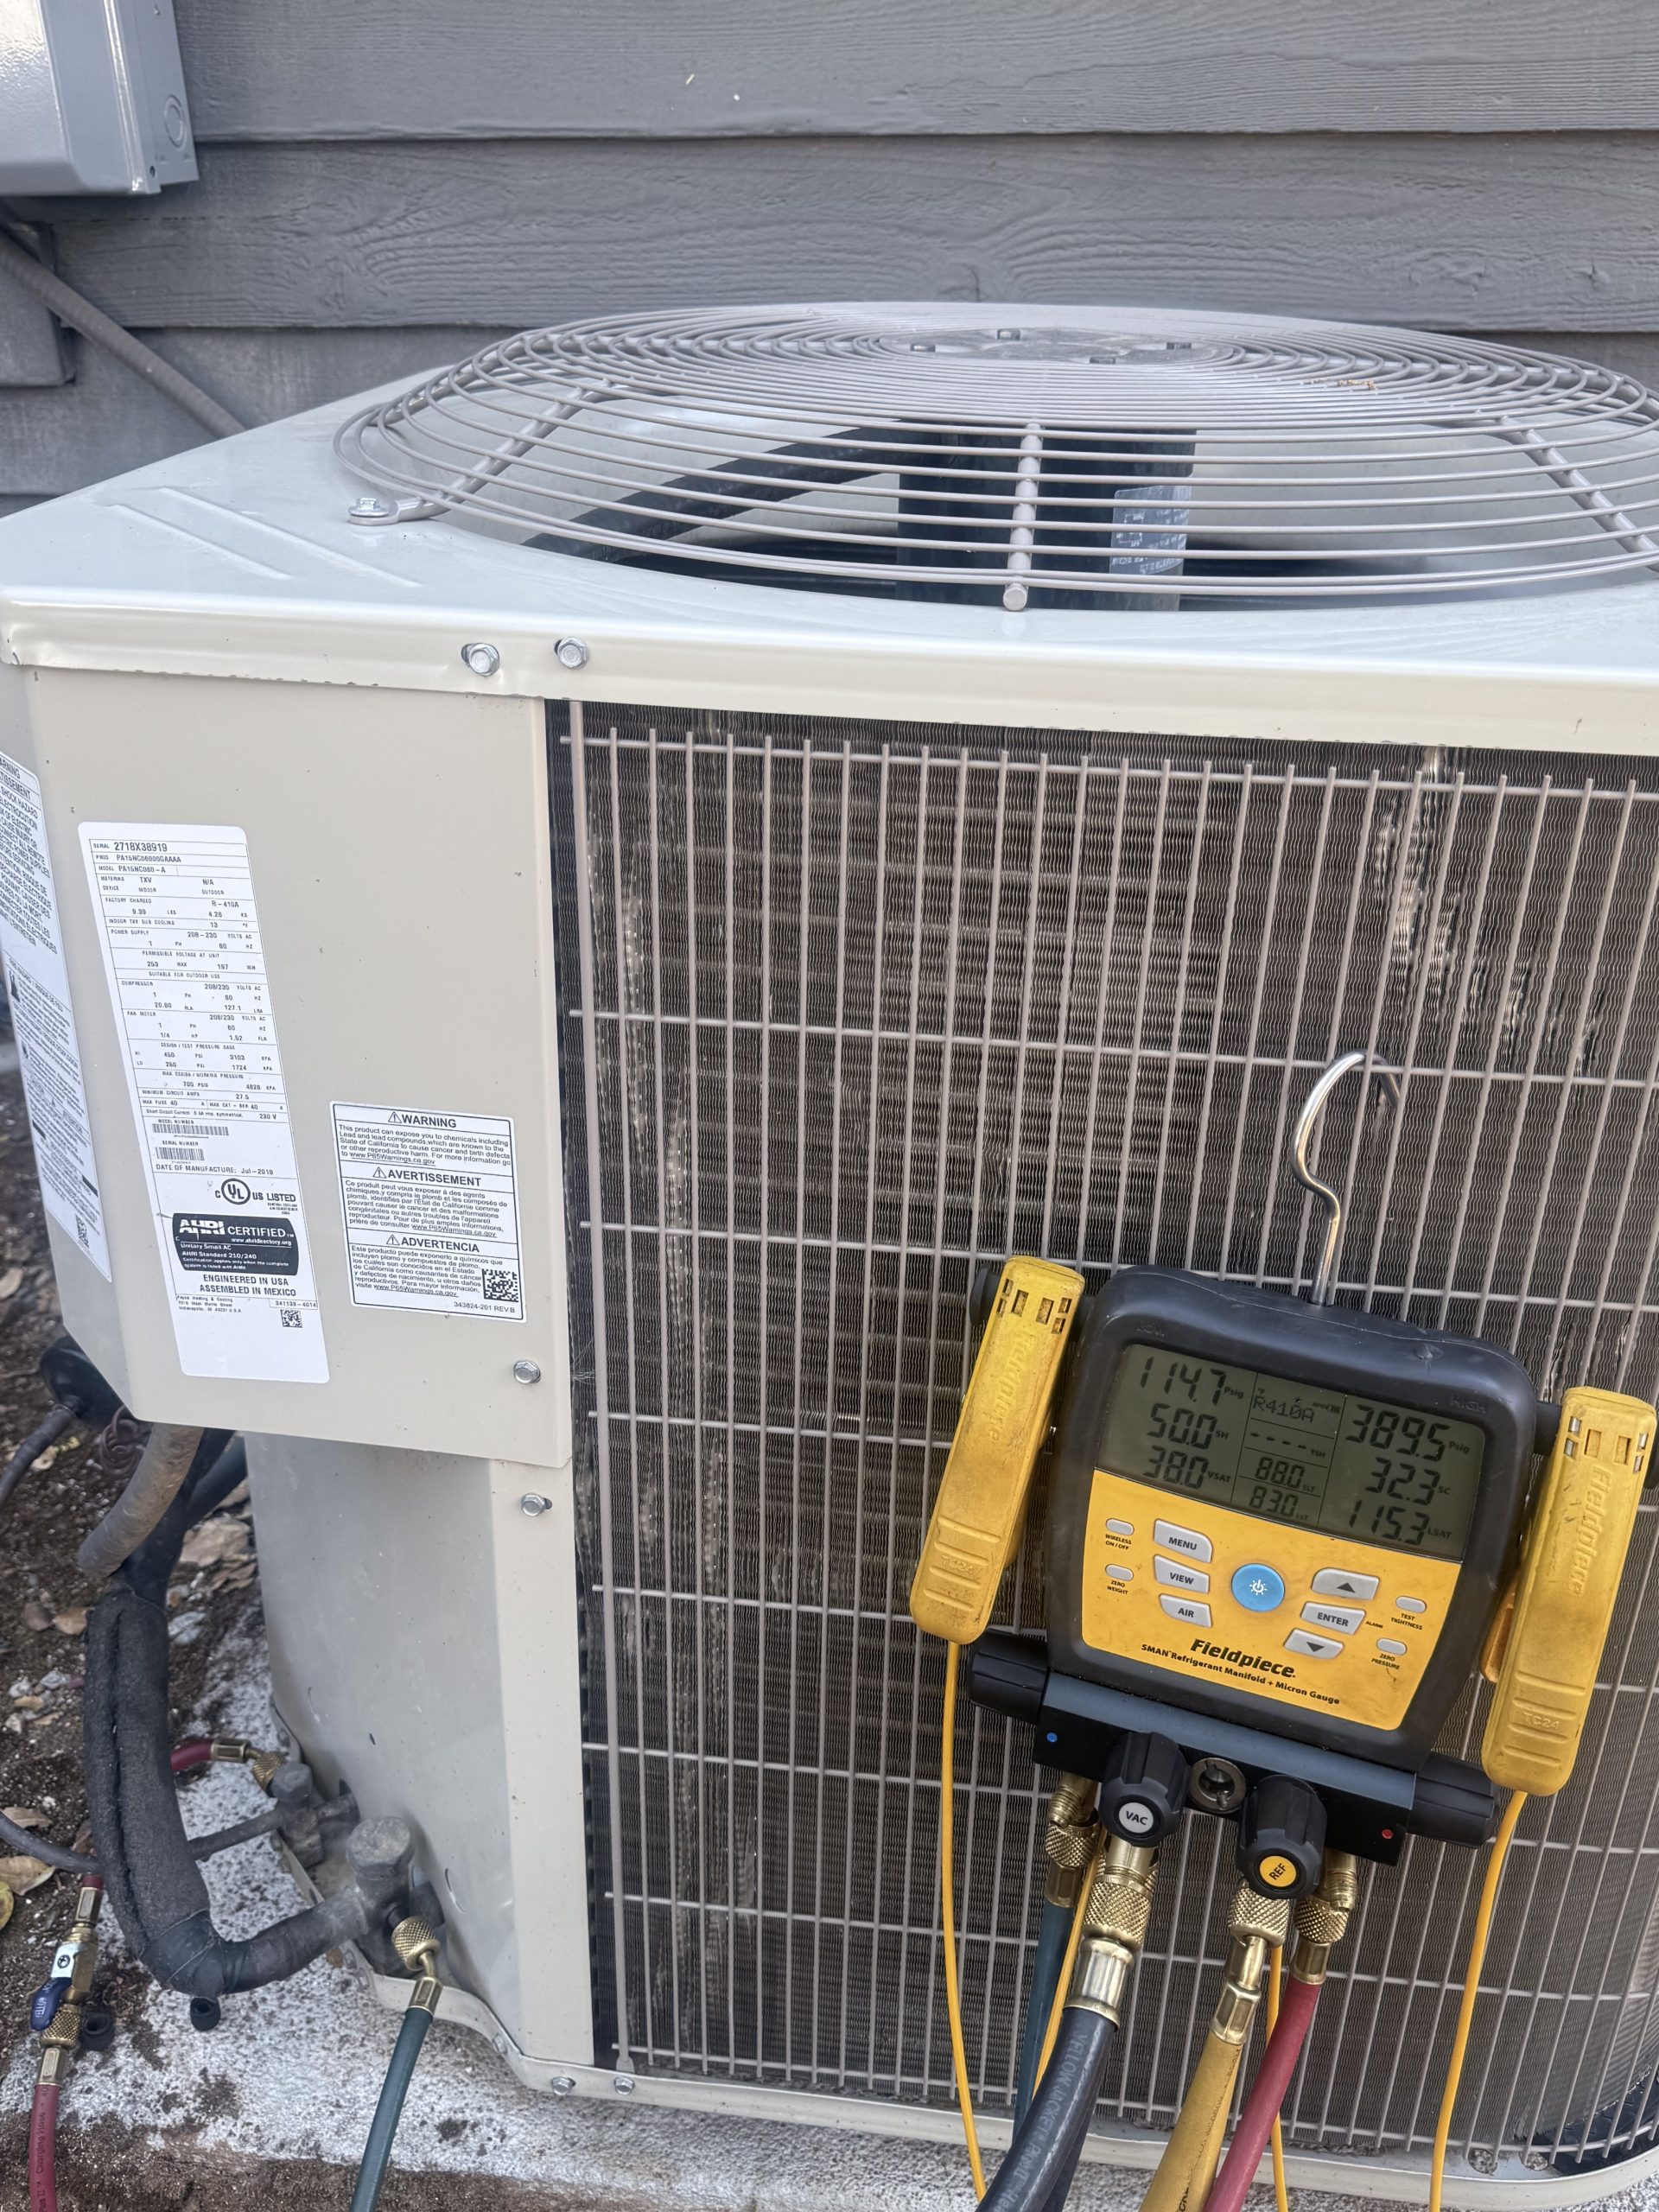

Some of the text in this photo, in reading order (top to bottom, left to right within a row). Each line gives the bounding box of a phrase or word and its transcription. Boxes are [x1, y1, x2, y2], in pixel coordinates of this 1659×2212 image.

[113, 842, 168, 851] 2718X38919
[401, 1114, 456, 1128] WARNING
[354, 1126, 379, 1135] product
[443, 1134, 476, 1142] chemicals
[479, 1137, 508, 1147] including
[367, 1147, 500, 1164] reproductive information
[387, 1169, 481, 1186] AVERTISSEMENT
[227, 1184, 245, 1199] UL
[266, 1192, 296, 1201] LISTED
[452, 1209, 499, 1218] malformations
[177, 1219, 286, 1237] AHRI CERTIFIED
[367, 1247, 397, 1255] producto
[401, 1236, 480, 1253] ADVERTENCIA
[202, 1274, 256, 1283] ENGINEERED
[199, 1284, 249, 1294] ASSEMBLED
[264, 1287, 296, 1296] MEXICO
[454, 1301, 492, 1310] 343824-201
[1140, 1357, 1244, 1406] 114.7 Psig
[1253, 1395, 1314, 1423] R410A
[1147, 1403, 1230, 1450] 50.0 SH
[1345, 1404, 1470, 1462] 389.5 Psig
[1143, 1445, 1232, 1490] 38.0 VSAT
[1255, 1456, 1305, 1489] 88.0
[1364, 1456, 1452, 1507] 32.3 SC
[1349, 1500, 1452, 1546] 115.3 LSAT
[1568, 1465, 1612, 1595] Fieldpiece
[1105, 1534, 1132, 1545] WIRELESS
[1168, 1537, 1198, 1550] MENU
[1169, 1573, 1194, 1585] VIEW
[1106, 1586, 1128, 1595] WEIGHT
[1178, 1608, 1194, 1618] AIR
[1317, 1611, 1349, 1627] ENTER
[1365, 1620, 1383, 1629] ALARM
[1390, 1617, 1423, 1630] TIGHTNESS
[1190, 1638, 1295, 1678] Fieldpiece
[1371, 1658, 1401, 1670] PRESSURE
[1170, 1652, 1223, 1673] Refrigerant
[1224, 1668, 1266, 1684] Manifold
[1274, 1681, 1307, 1696] Micron
[1309, 1691, 1340, 1705] Gauge
[1522, 1713, 1560, 1729] TC24
[1126, 1810, 1148, 1826] VAC
[1268, 1862, 1287, 1881] REF
[1059, 2033, 1088, 2087] YELLOW
[36, 2113, 46, 2174] Charging Hose
